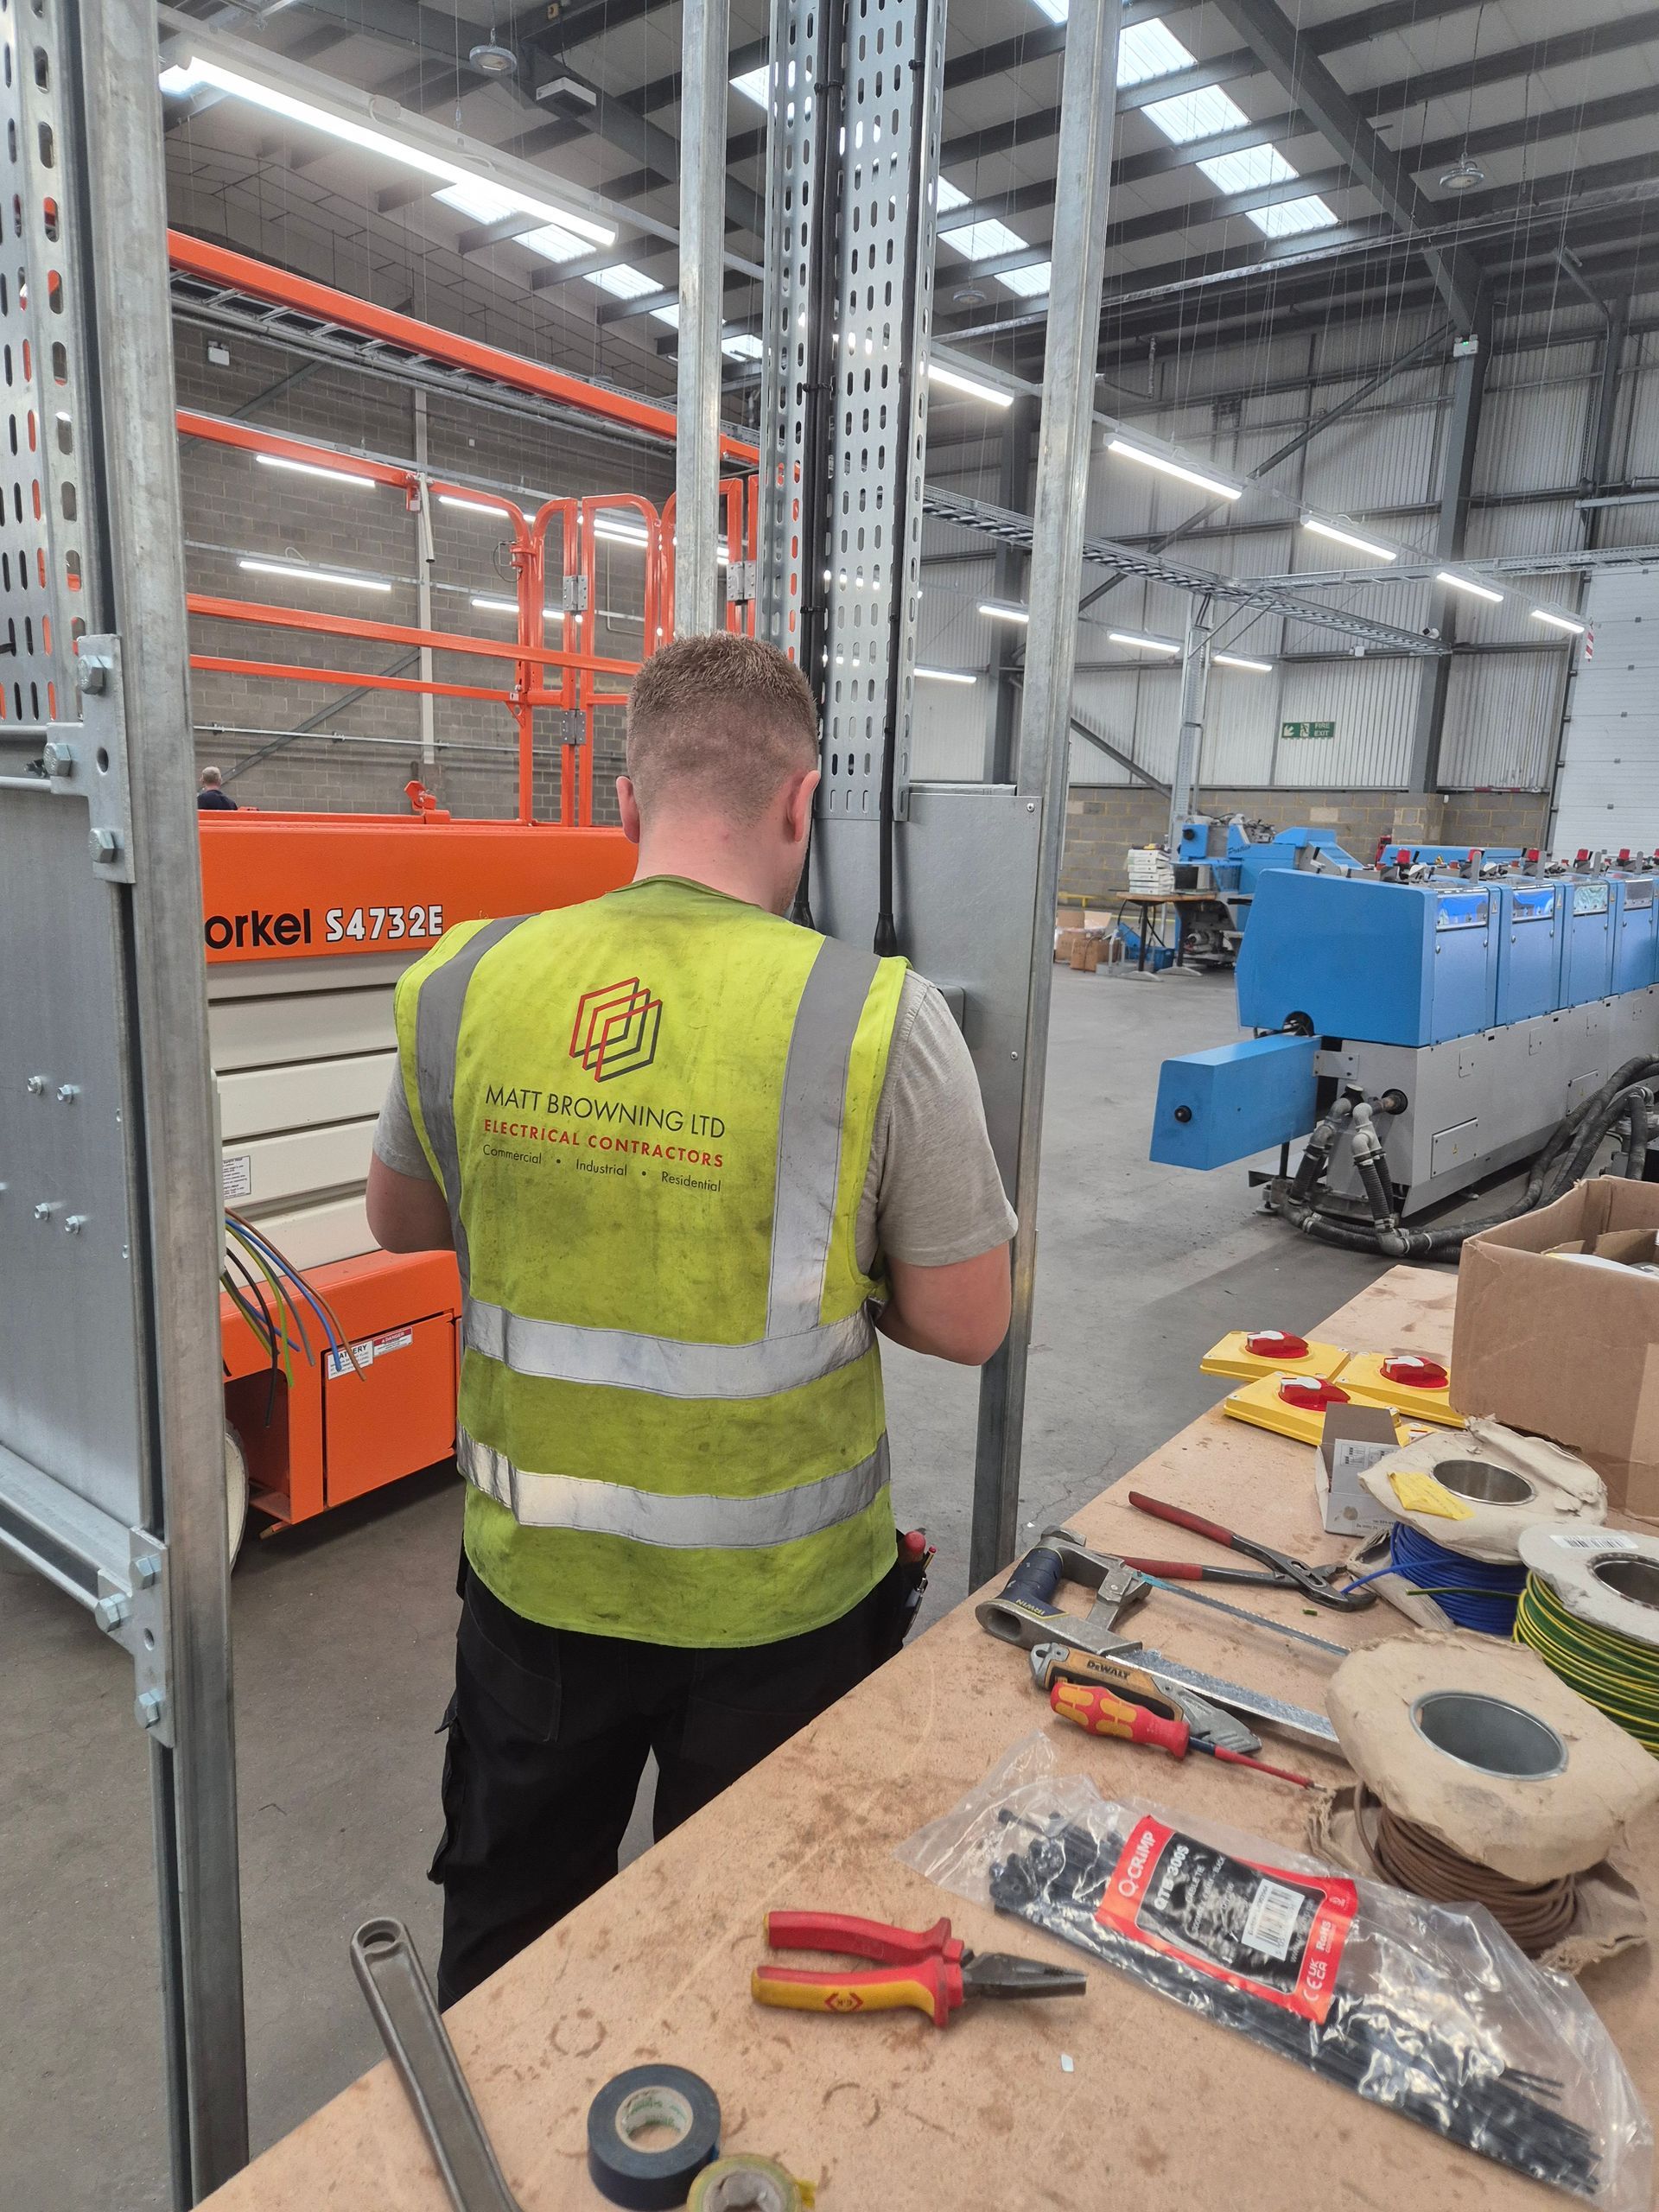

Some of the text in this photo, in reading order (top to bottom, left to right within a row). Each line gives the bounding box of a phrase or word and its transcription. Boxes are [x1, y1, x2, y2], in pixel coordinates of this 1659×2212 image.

[326, 905, 443, 943] S4732E
[486, 1084, 725, 1138] MATT BROWNING LTD
[484, 1119, 724, 1167] ELECTRICAL CONTRACTORS
[483, 1144, 721, 1192] Commercial Industrial Residential
[1015, 1599, 1046, 1616] IRWIN
[1154, 1844, 1189, 1910] QTB 300S
[1185, 1865, 1205, 1903] CABLE TIE
[1316, 1920, 1332, 1951] RoHS
